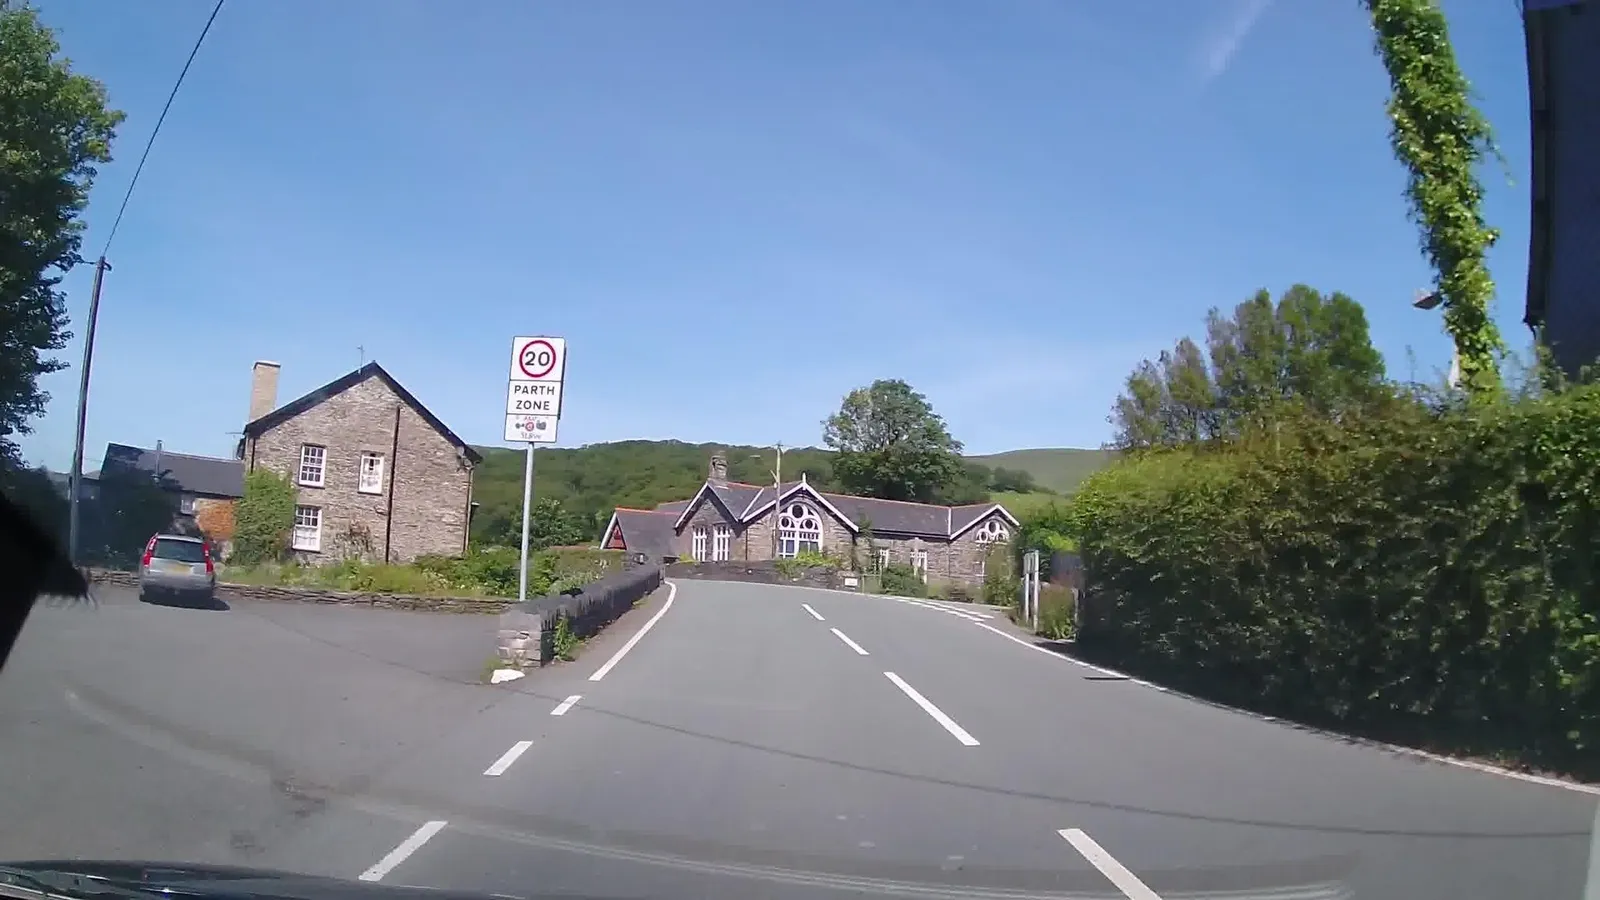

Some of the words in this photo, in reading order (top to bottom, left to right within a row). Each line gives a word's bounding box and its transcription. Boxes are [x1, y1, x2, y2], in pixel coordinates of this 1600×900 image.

[524, 351, 551, 366] 20
[514, 385, 555, 396] PARTH
[515, 400, 550, 411] ZONE
